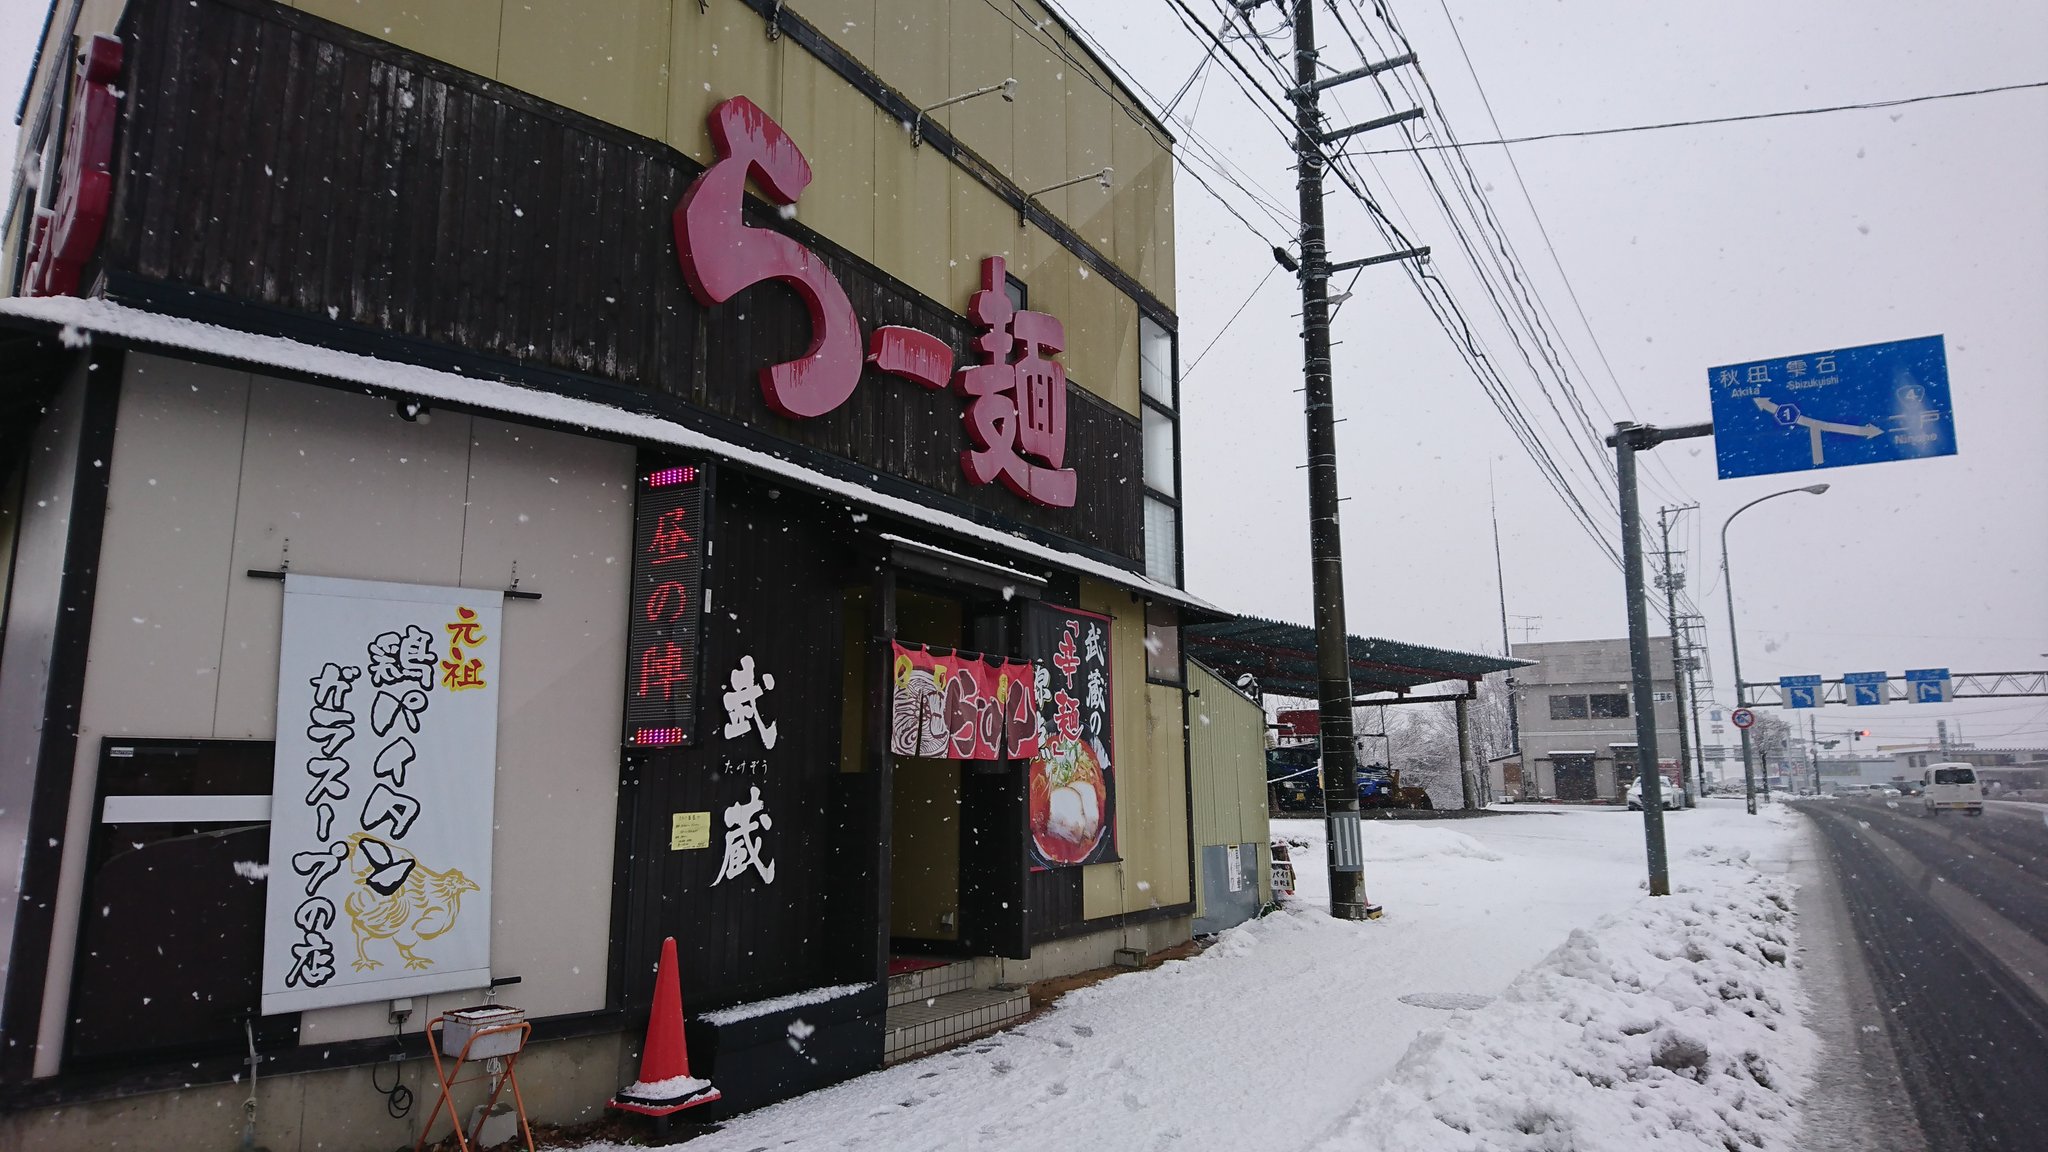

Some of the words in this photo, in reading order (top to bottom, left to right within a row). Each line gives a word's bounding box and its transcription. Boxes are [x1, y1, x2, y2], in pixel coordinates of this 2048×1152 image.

[673, 95, 1077, 508] らー麺
[1720, 365, 1769, 388] 秋田
[1786, 355, 1837, 377] 雫石
[1731, 386, 1760, 398] Akita
[1786, 375, 1839, 390] Shizukuishi
[441, 605, 488, 691] 元祖
[640, 507, 695, 702] 昼の陣
[1084, 621, 1106, 735] 武蔵の
[358, 624, 438, 897] 鶏パイタン
[724, 759, 769, 774] たけぞう
[286, 662, 361, 988] ガラスープの店
